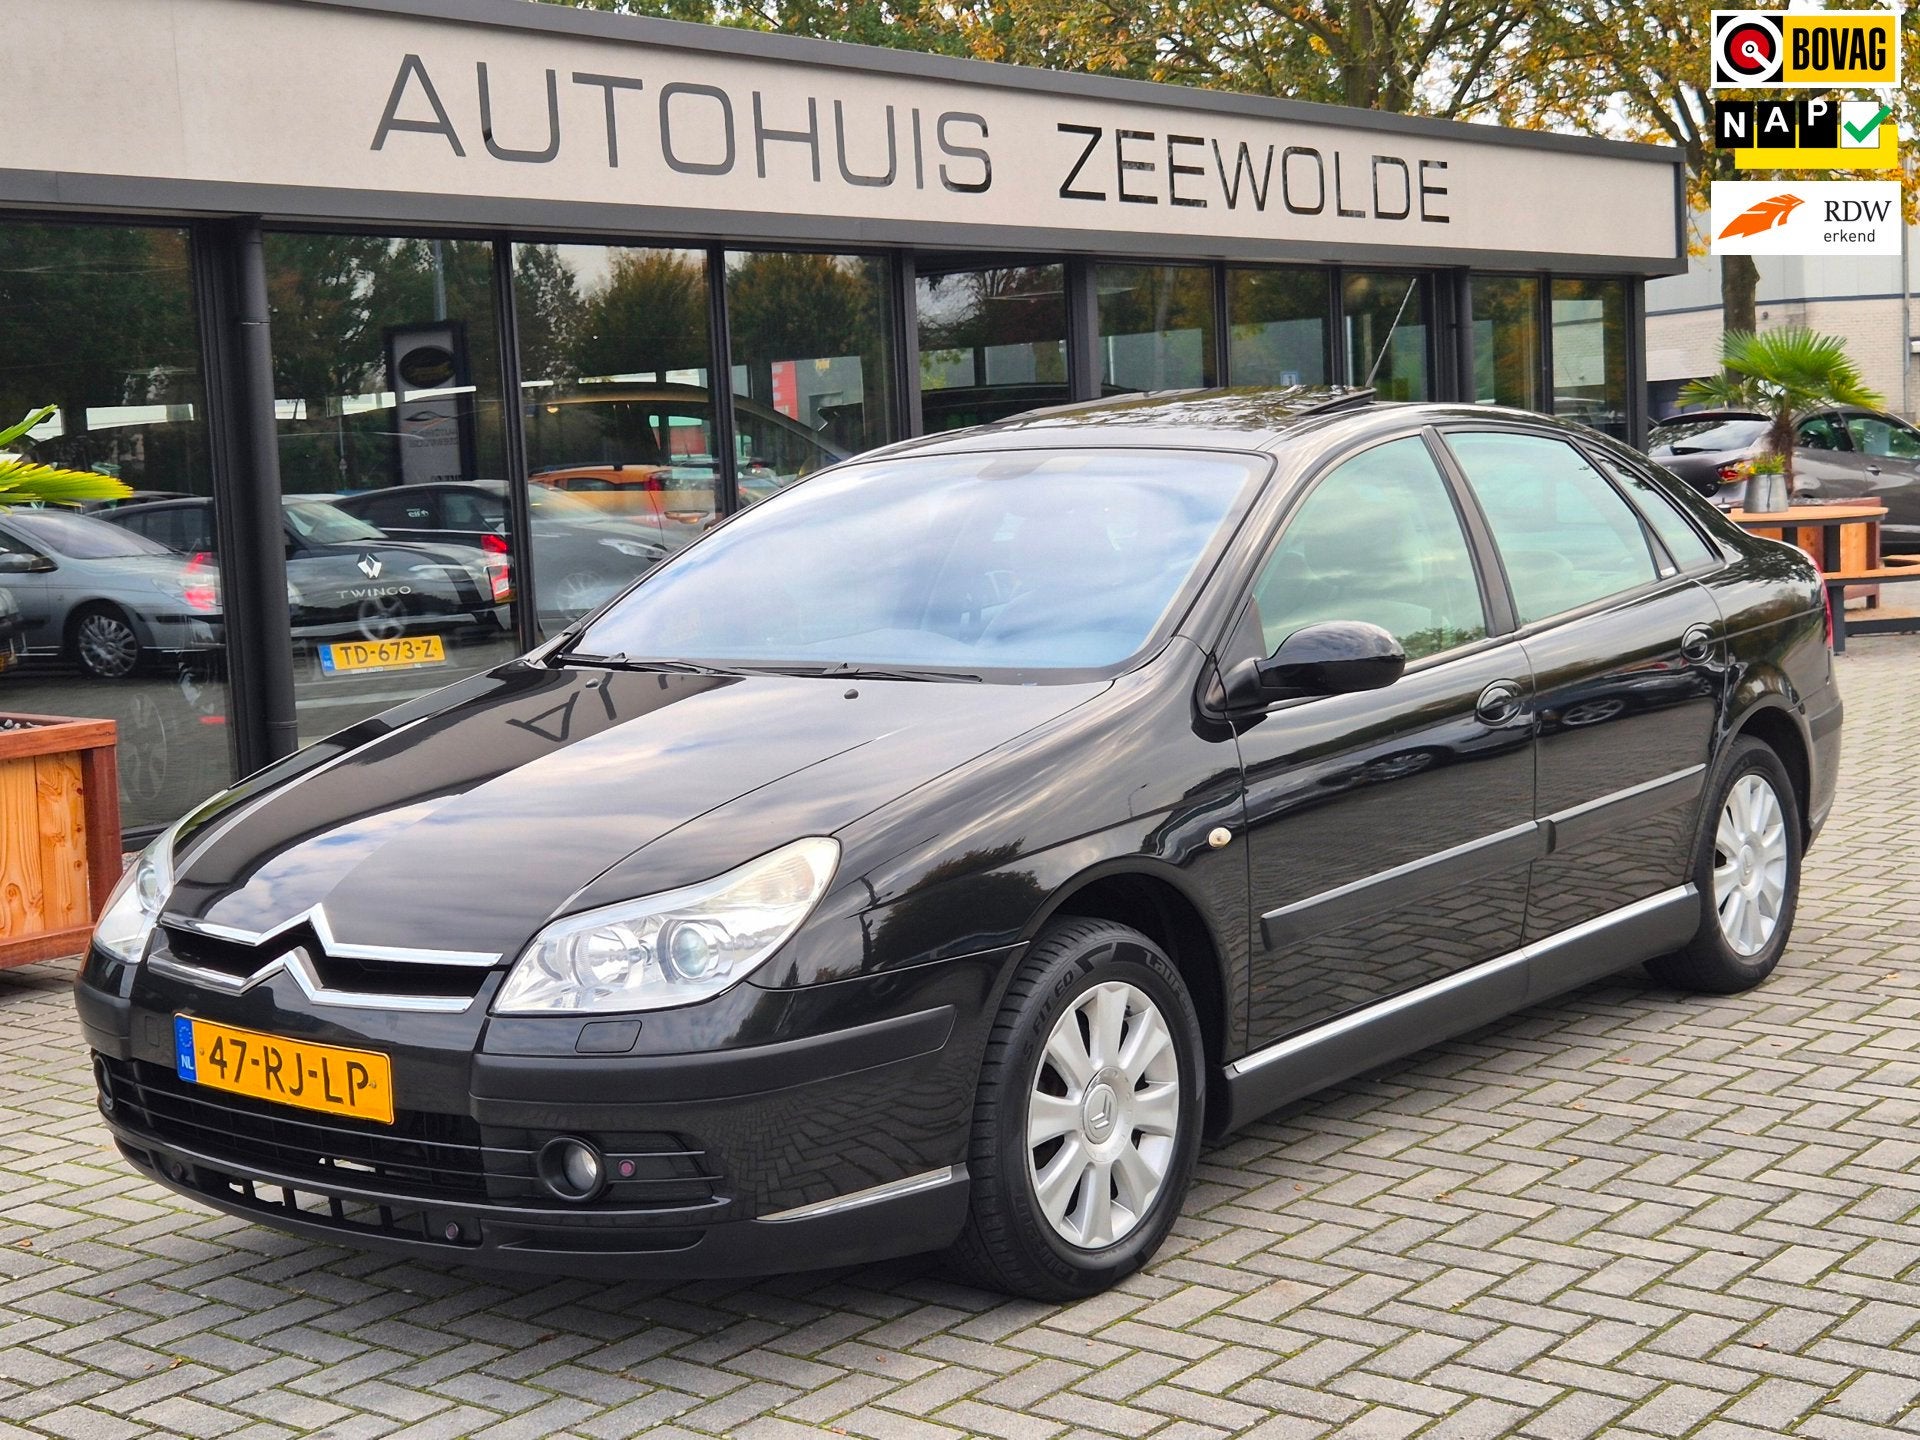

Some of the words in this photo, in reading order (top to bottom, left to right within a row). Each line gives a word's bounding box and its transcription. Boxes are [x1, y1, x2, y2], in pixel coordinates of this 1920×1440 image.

[369, 53, 993, 194] AUTOHUIS
[1057, 122, 1450, 224] ZEEWOLDE
[336, 585, 412, 599] TWINGO
[338, 639, 435, 666] TD-673-Z
[181, 1054, 194, 1070] NL
[208, 1035, 370, 1107] 47-RJ-LP
